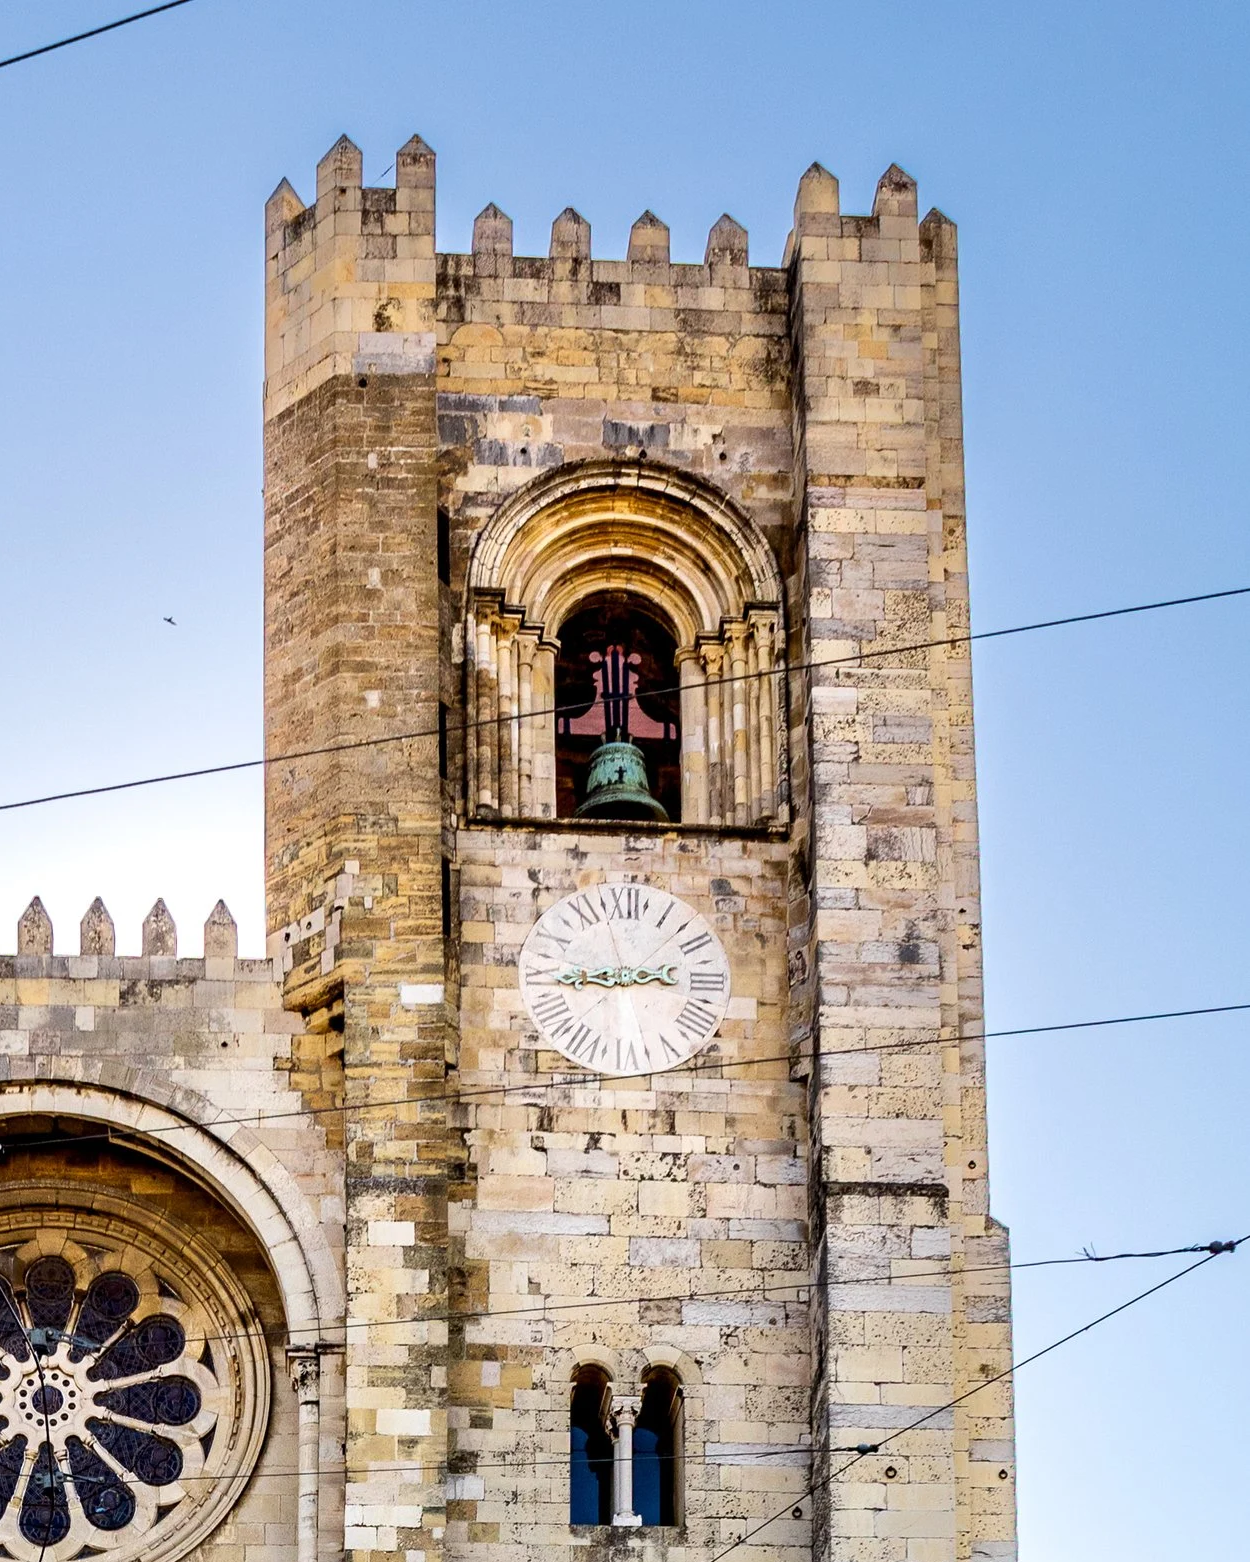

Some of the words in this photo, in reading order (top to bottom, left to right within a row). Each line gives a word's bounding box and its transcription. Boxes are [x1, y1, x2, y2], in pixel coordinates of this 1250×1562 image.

[567, 893, 601, 931] XI
[610, 888, 639, 921] XII
[535, 924, 573, 952] X
[679, 931, 712, 956] II
[690, 972, 724, 991] III
[531, 993, 574, 1038] VIII
[566, 1023, 601, 1063] VII
[616, 1038, 639, 1071] VI
[659, 1033, 681, 1064] V
